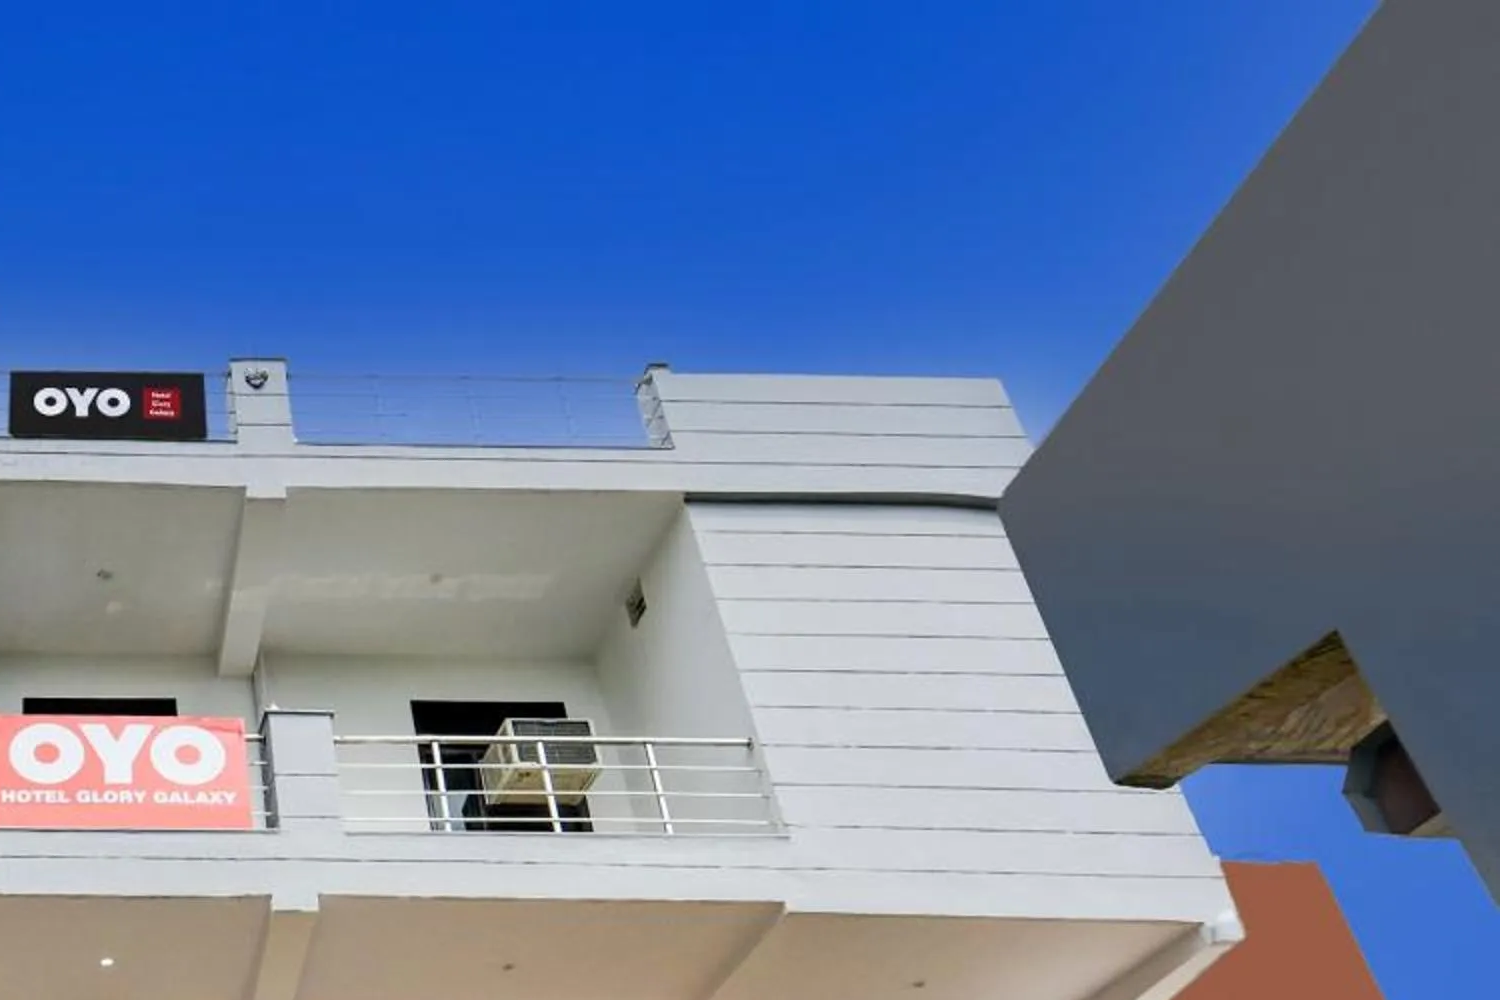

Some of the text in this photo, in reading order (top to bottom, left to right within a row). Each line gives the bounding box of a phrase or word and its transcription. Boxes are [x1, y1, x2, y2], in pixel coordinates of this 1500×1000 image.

[33, 387, 131, 418] OYO
[8, 722, 226, 786] OYO
[0, 789, 238, 805] HOTEL GLORY GALAXY
